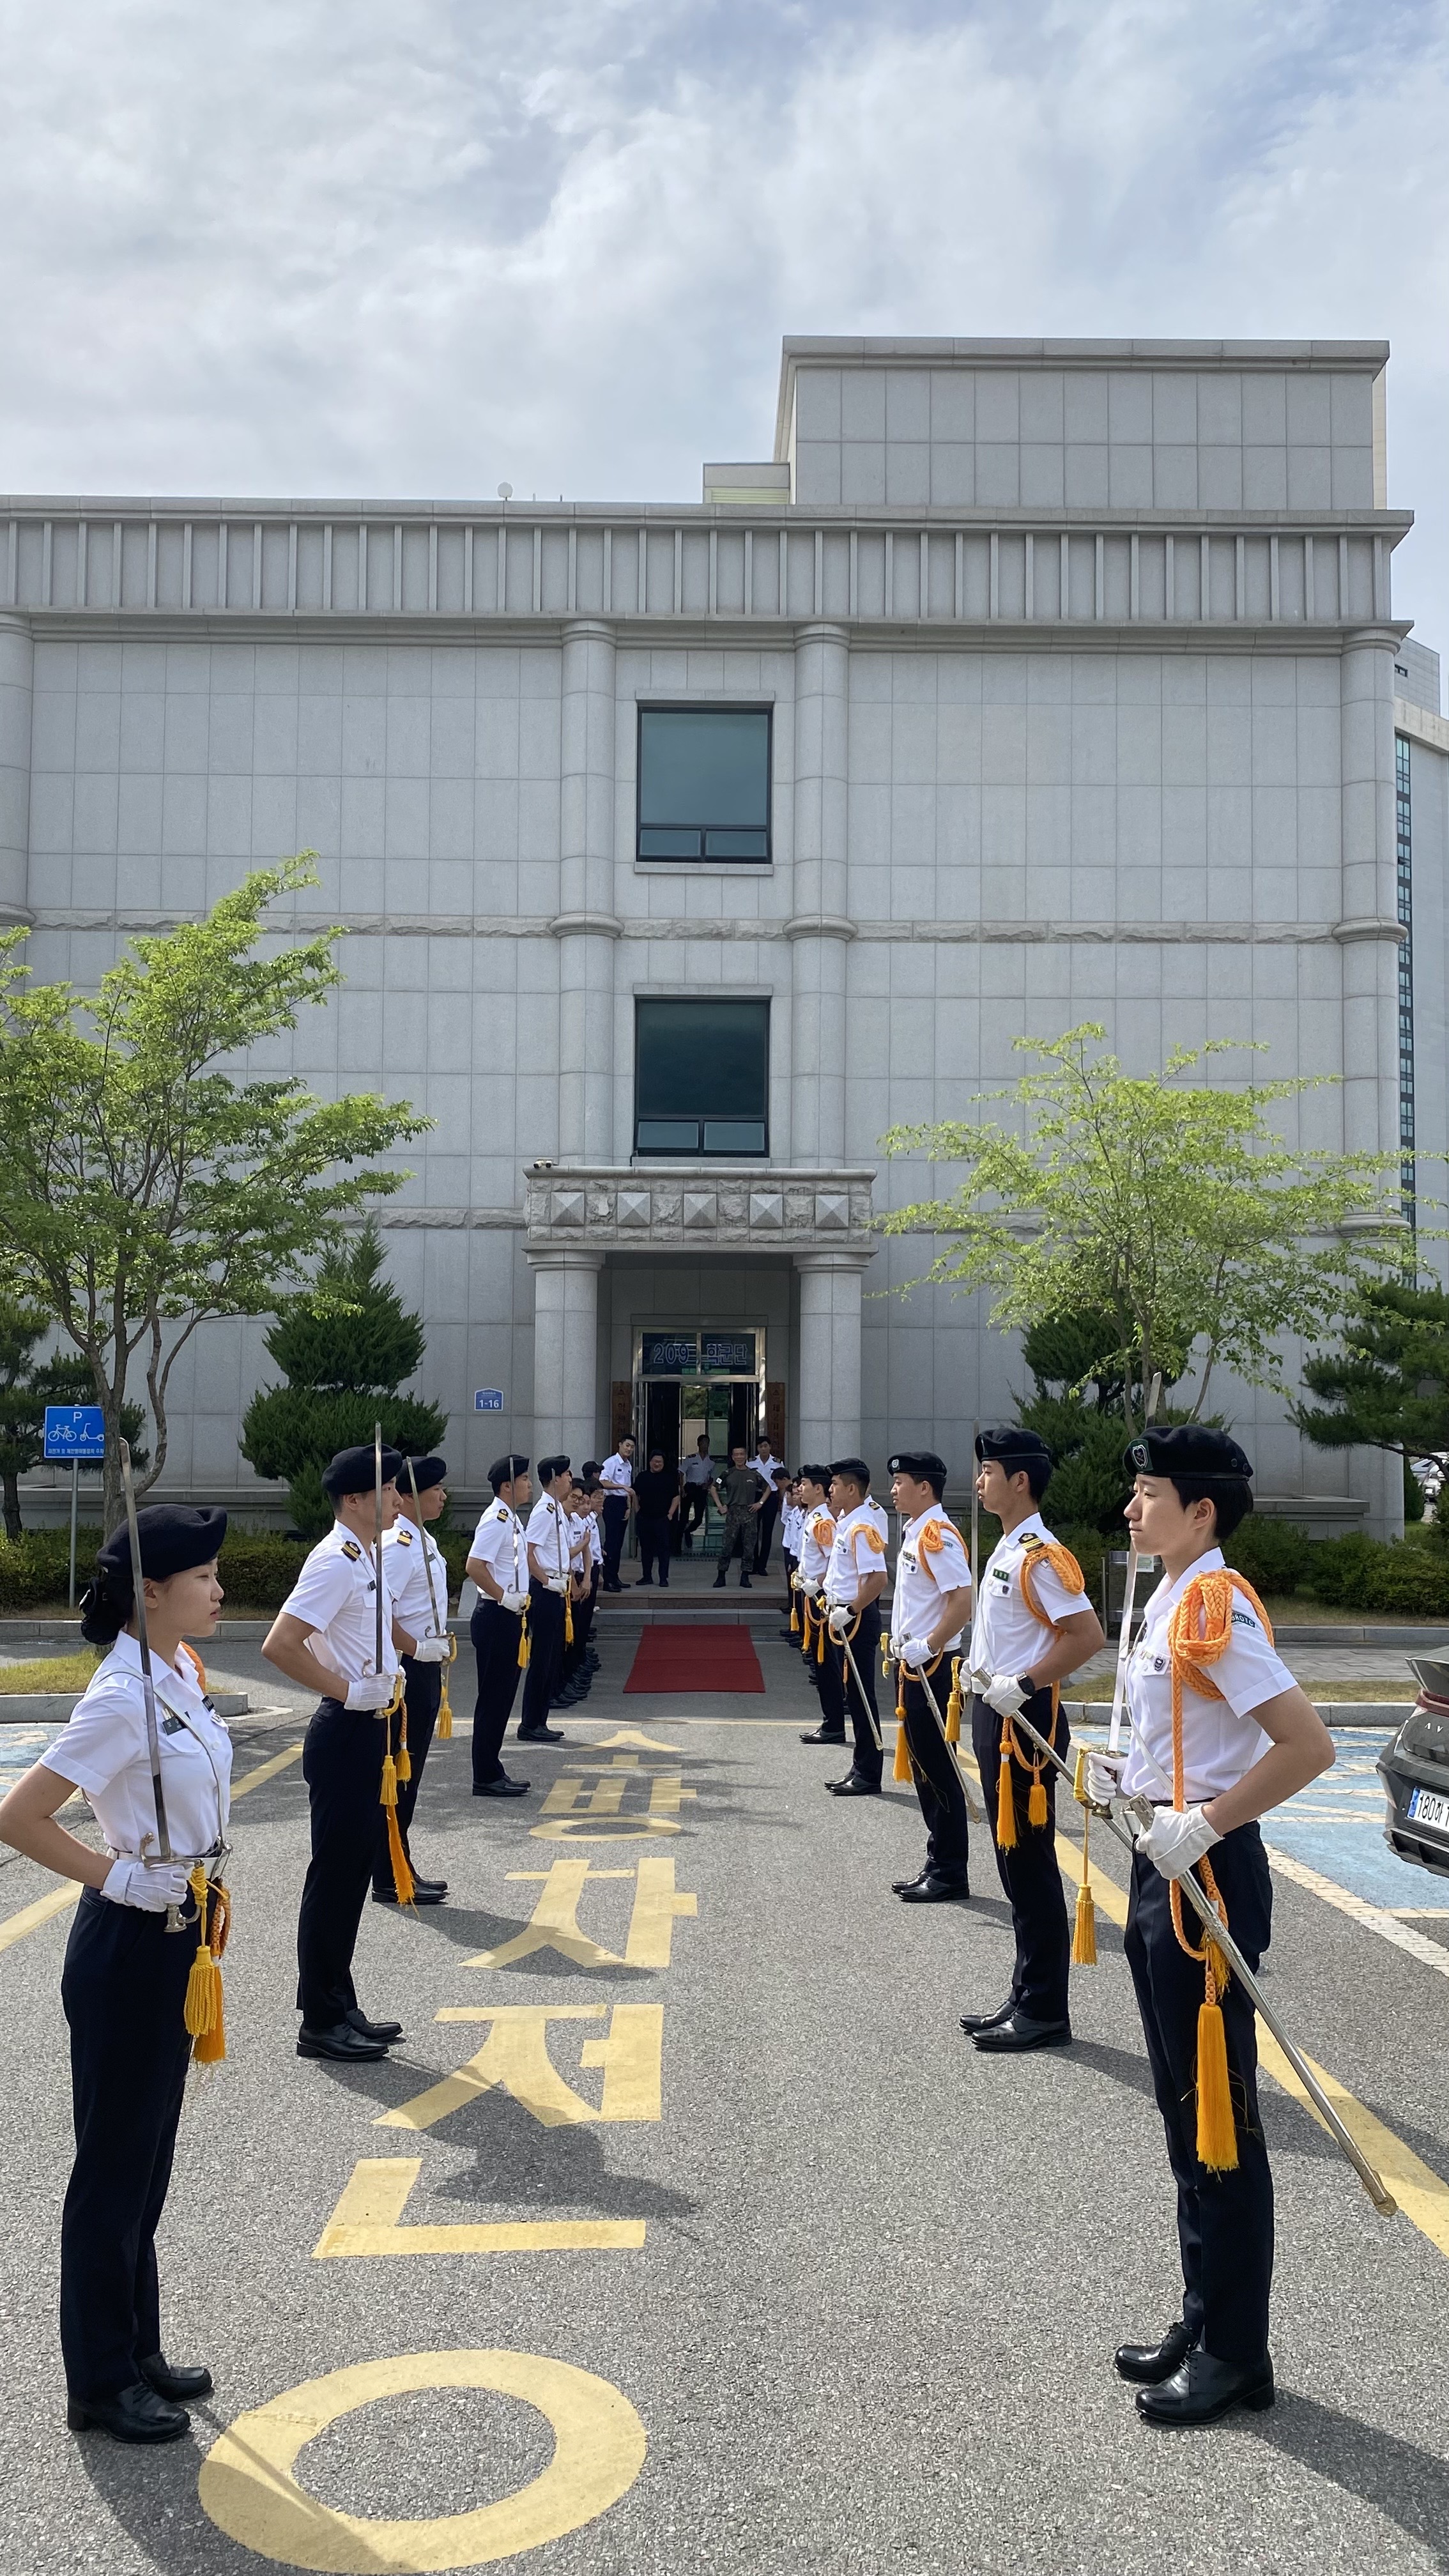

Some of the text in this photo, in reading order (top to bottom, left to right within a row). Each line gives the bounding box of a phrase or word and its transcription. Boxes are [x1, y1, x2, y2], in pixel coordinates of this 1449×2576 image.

[653, 1343, 747, 1365] 209 학군단
[479, 1399, 499, 1408] 1-16
[73, 1411, 82, 1423] P
[1418, 1794, 1444, 1823] 180하
